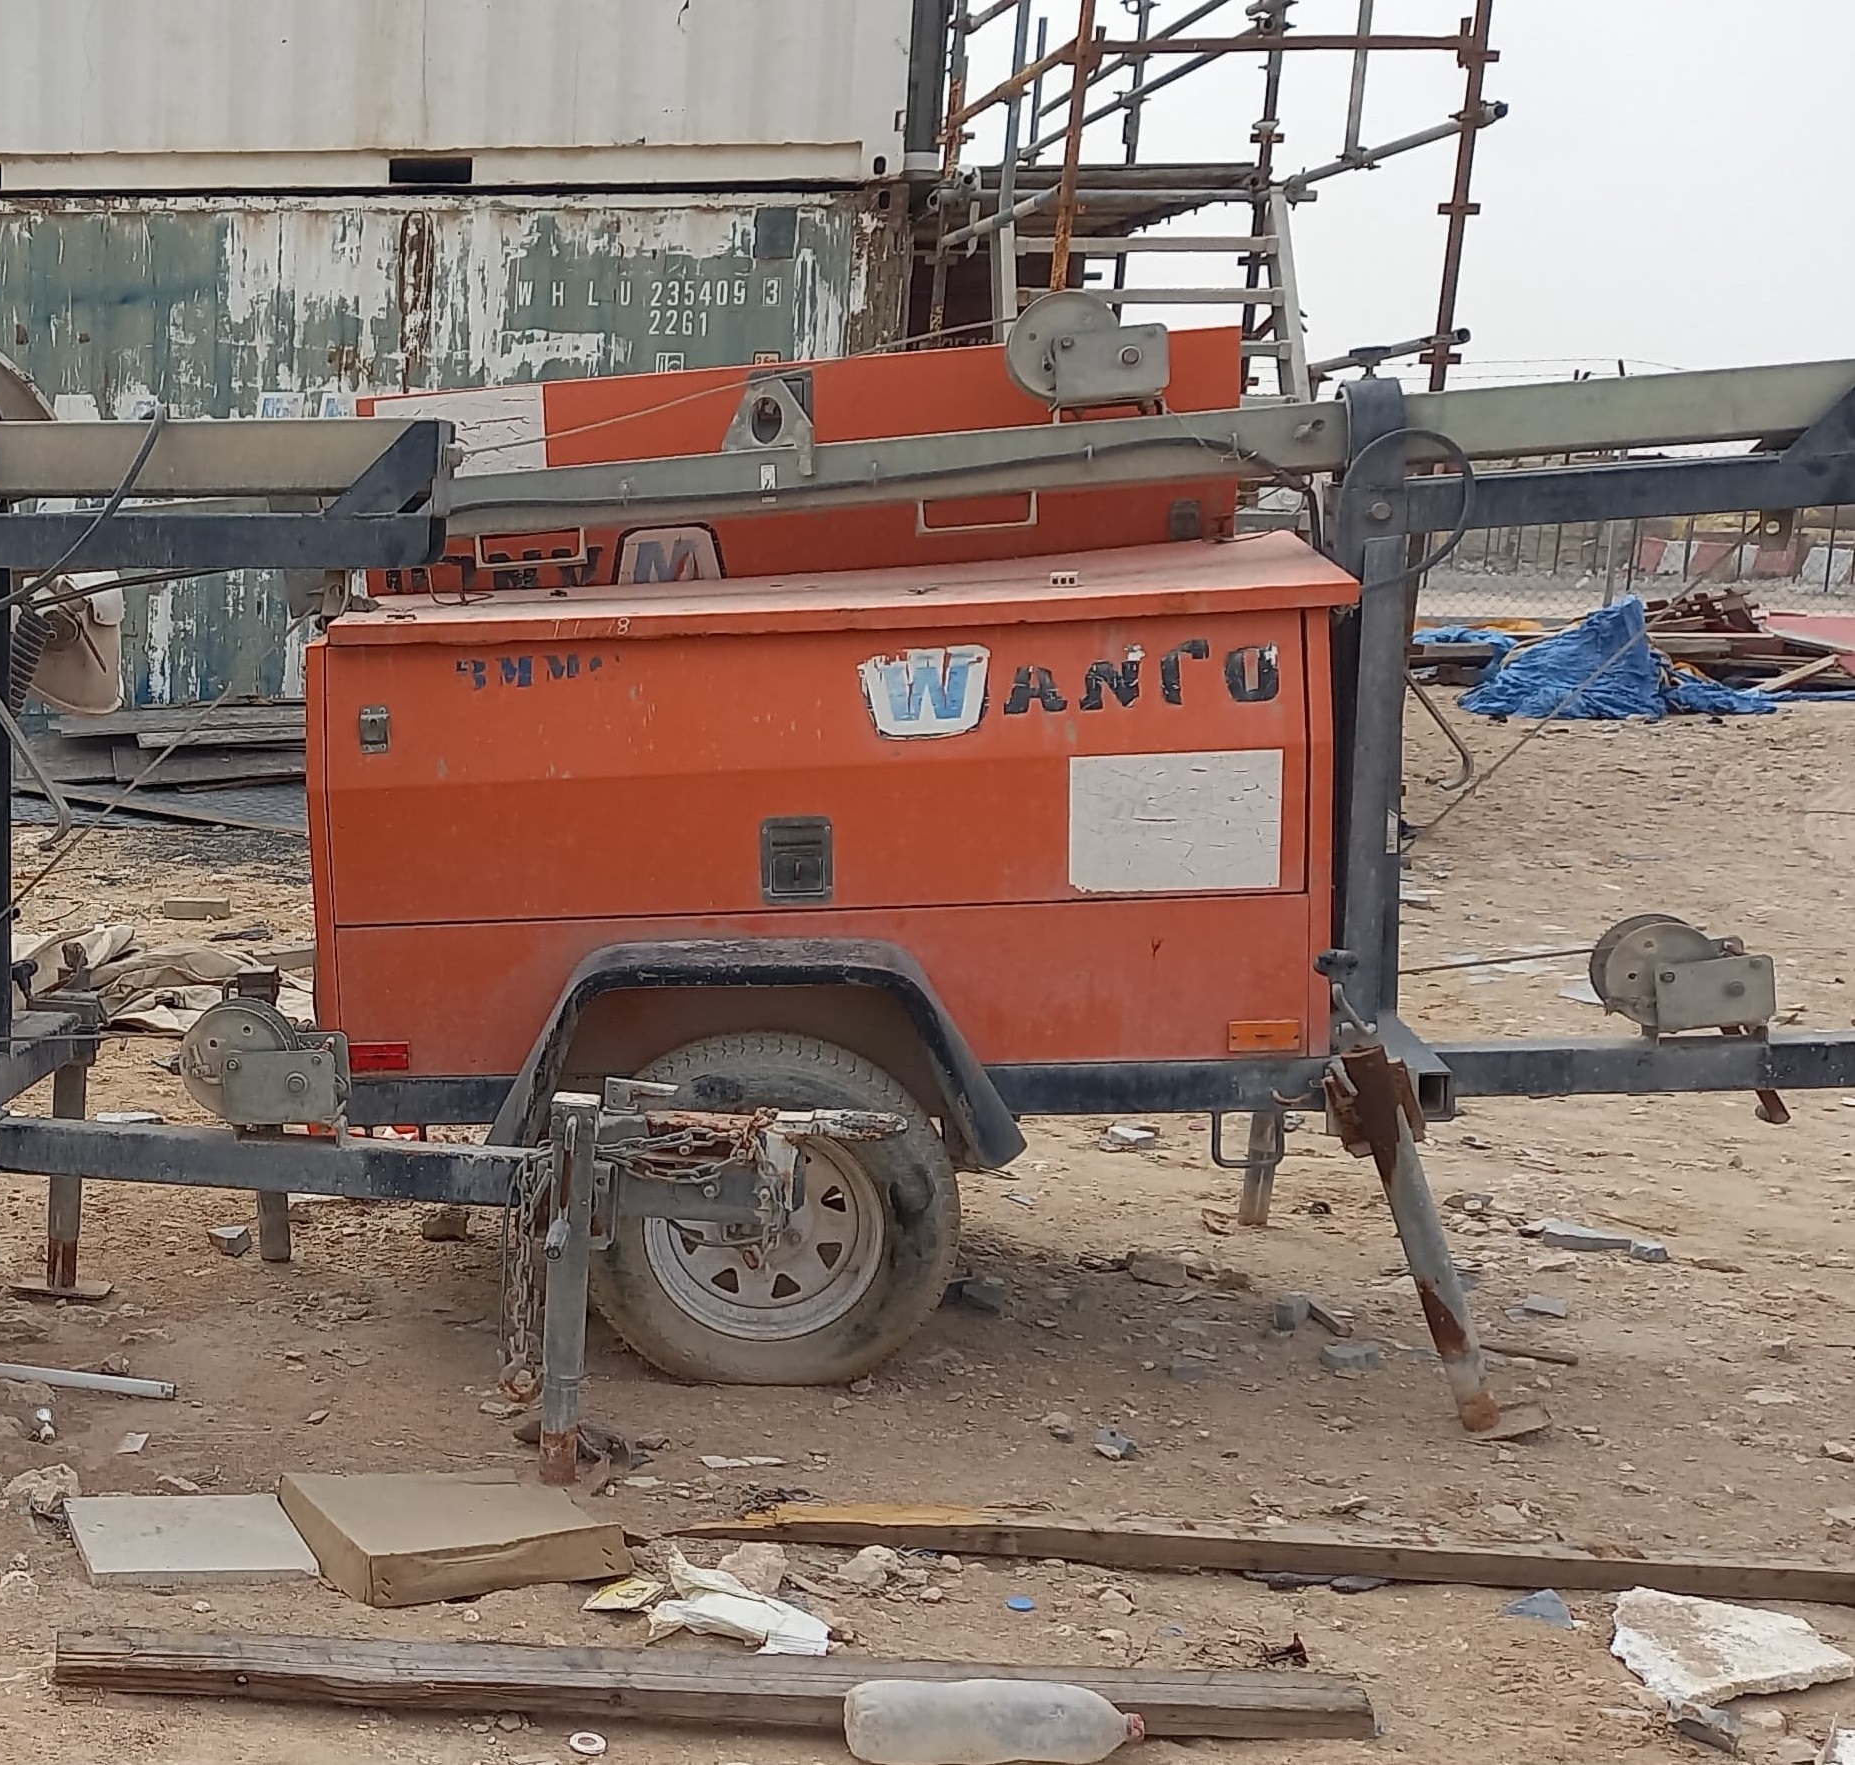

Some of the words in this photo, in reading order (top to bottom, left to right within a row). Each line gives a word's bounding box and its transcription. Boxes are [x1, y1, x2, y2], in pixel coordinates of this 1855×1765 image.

[649, 279, 747, 307] 235409
[764, 278, 781, 306] 3
[648, 309, 708, 337] 22G1
